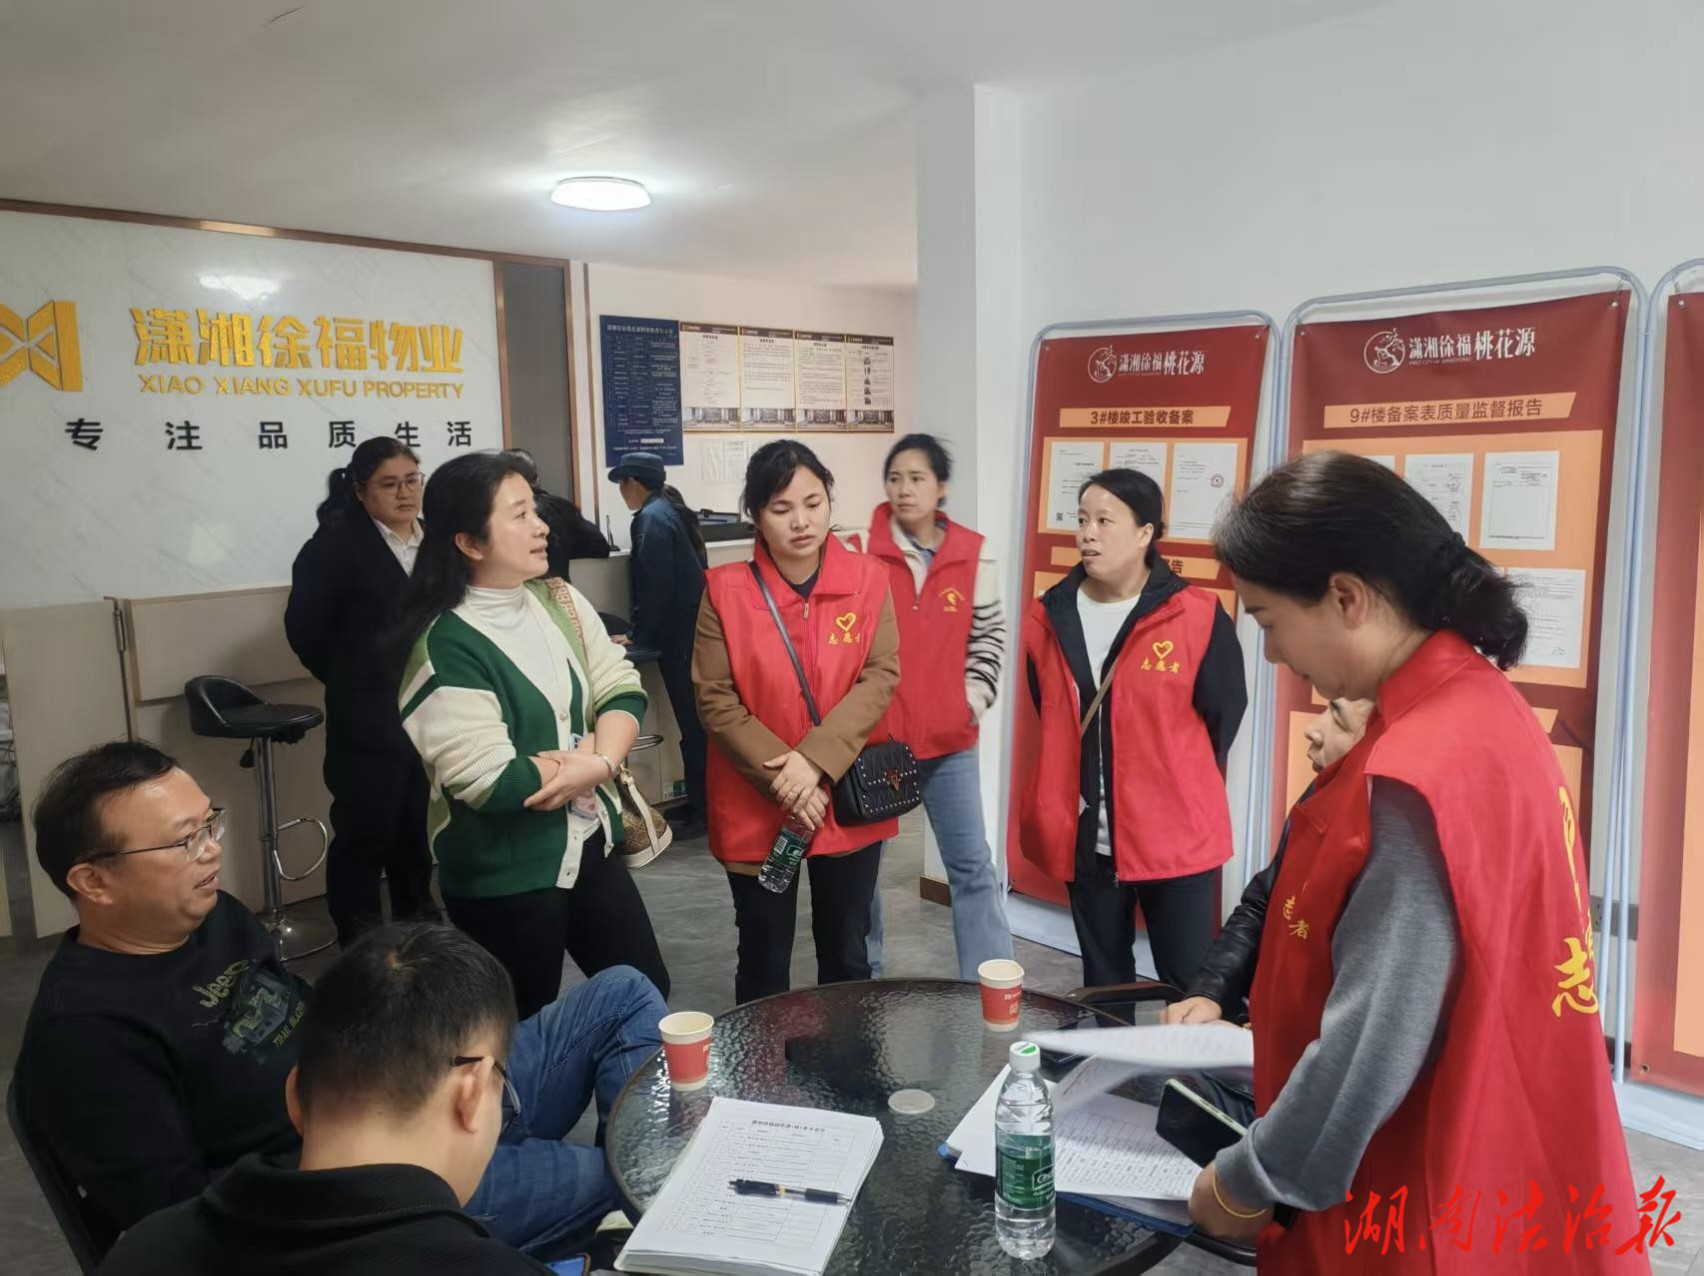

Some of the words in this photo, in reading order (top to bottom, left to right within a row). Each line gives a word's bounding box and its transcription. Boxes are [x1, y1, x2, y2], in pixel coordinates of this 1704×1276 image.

[130, 307, 464, 374] 潇湘徐福物业
[1409, 327, 1536, 361] 潇湘徐福桃花源
[139, 373, 204, 396] XIAO
[214, 375, 291, 398] XIANG
[298, 379, 358, 399] XUFU
[363, 380, 465, 400] PROPERTY
[1090, 408, 1195, 427] 3#楼竣工验收备案
[1349, 397, 1543, 425] 9#楼备案表质量监督报告
[65, 417, 472, 452] 专注品质生活
